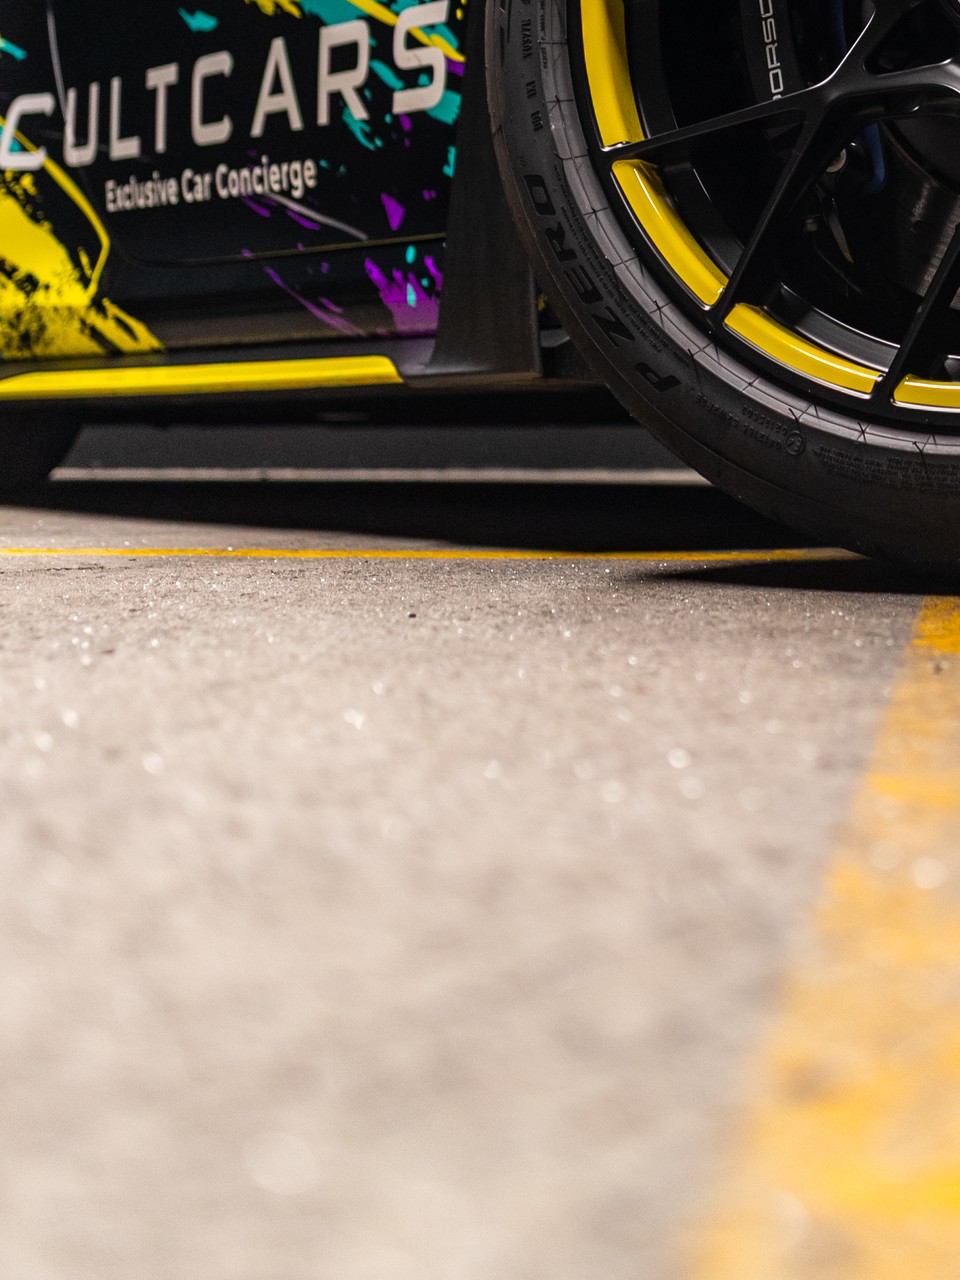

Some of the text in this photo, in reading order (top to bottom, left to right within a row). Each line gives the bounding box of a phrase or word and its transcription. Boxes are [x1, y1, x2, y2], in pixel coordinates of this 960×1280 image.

[105, 154, 318, 213] Exclusive Car Concierge
[523, 174, 635, 348] ZERO
[634, 362, 682, 393] P
